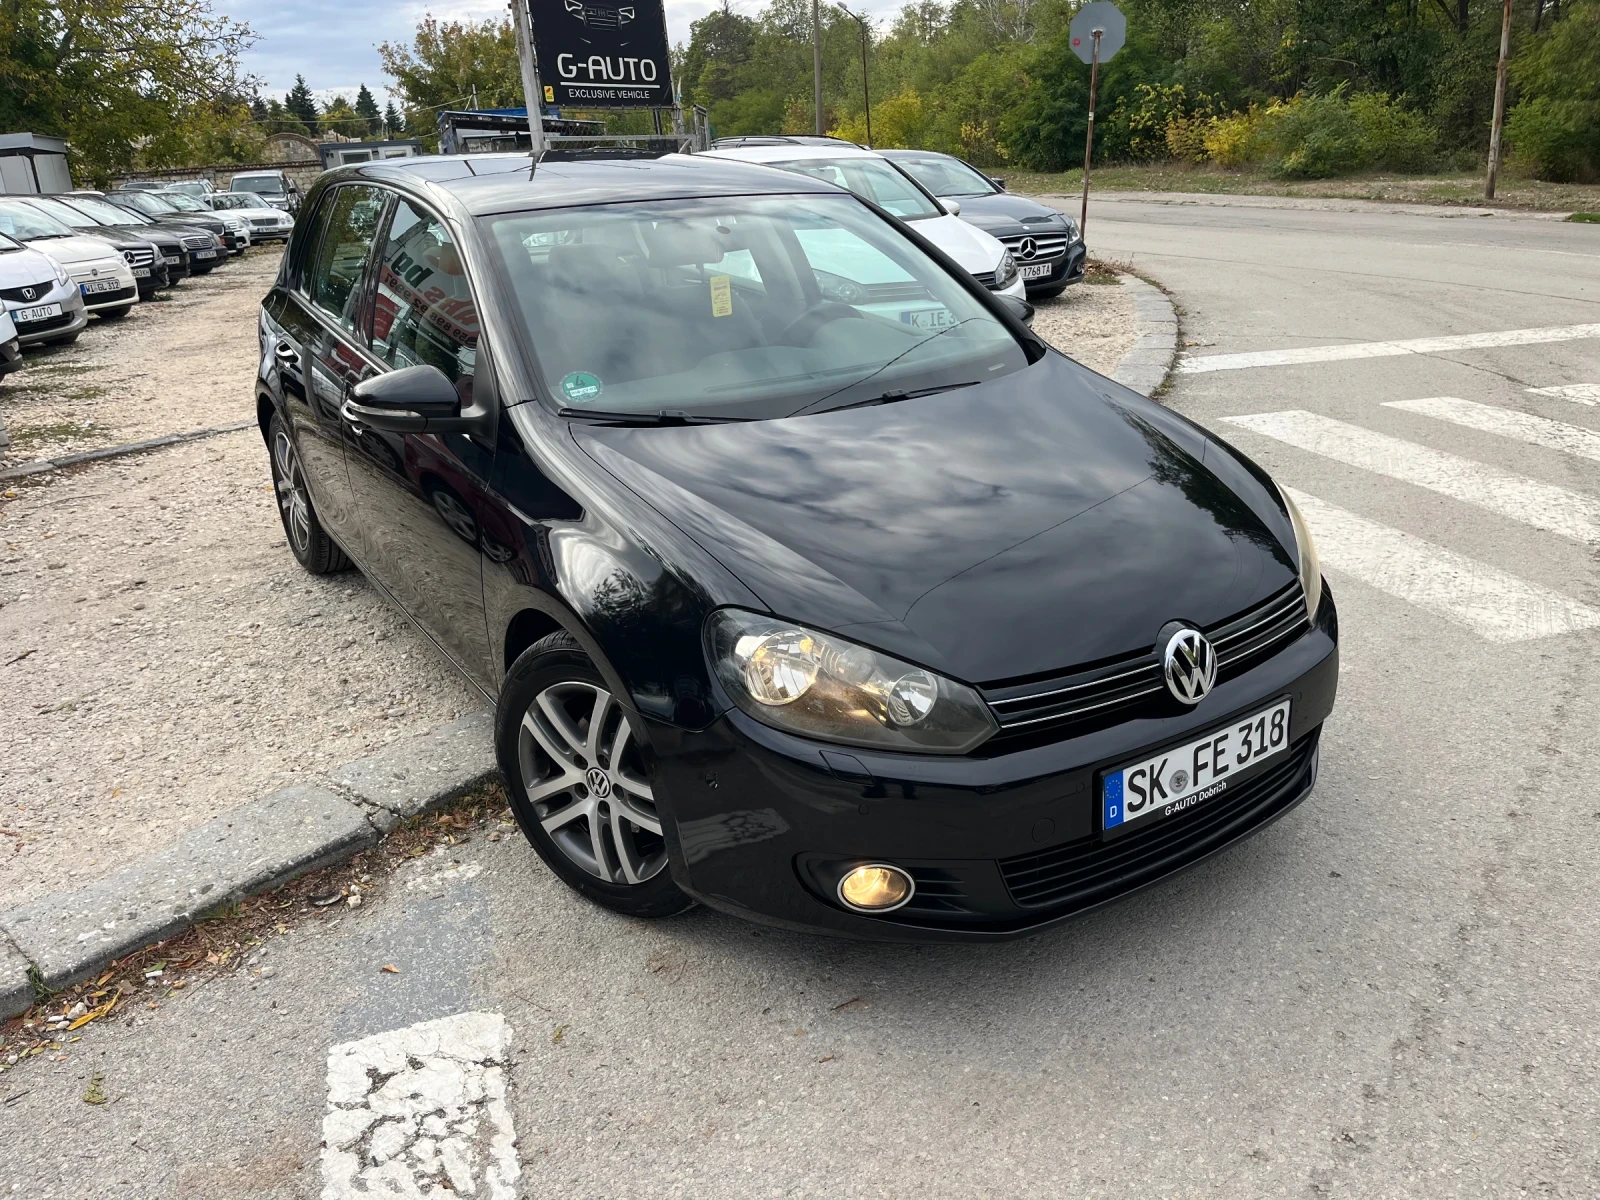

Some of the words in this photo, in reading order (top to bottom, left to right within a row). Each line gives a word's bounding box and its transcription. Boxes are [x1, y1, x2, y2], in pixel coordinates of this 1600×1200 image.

[557, 53, 657, 81] G-AUTO
[568, 88, 616, 99] EXCLUSIVE
[617, 90, 650, 99] VEHICLE
[1023, 266, 1041, 277] 1768
[1042, 264, 1051, 275] TA
[107, 281, 120, 290] 312
[911, 314, 920, 328] K
[930, 311, 946, 327] IE
[1109, 805, 1118, 819] D
[1127, 758, 1169, 813] SK
[1192, 733, 1229, 788] FE
[1236, 708, 1286, 765] 318
[1164, 796, 1197, 816] G-AUTO
[1198, 780, 1227, 802] Dobrich
